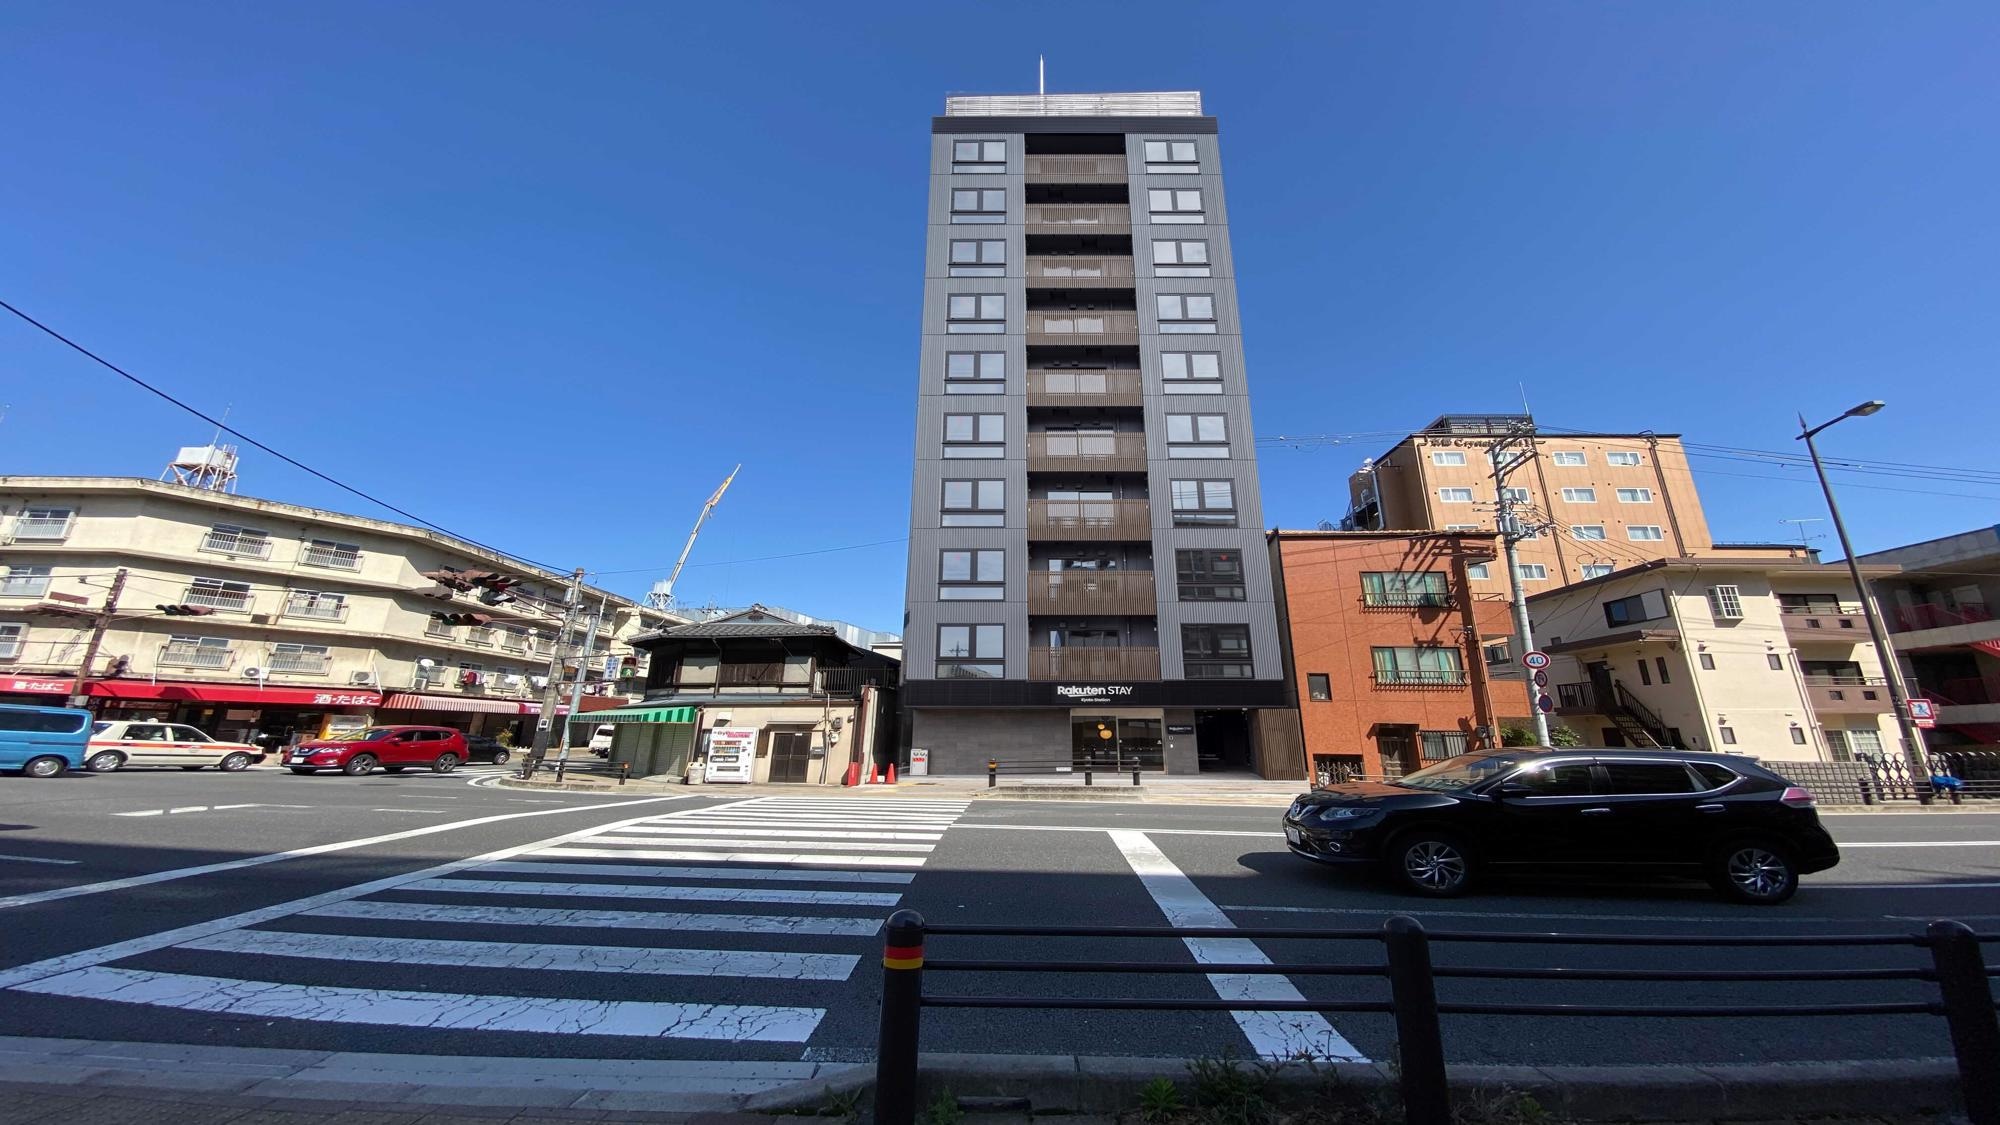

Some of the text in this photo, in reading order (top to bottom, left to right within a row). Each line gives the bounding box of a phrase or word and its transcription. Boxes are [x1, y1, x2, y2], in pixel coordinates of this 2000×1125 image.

[1529, 656, 1544, 665] 40
[1057, 685, 1133, 697] Rakuten STAY
